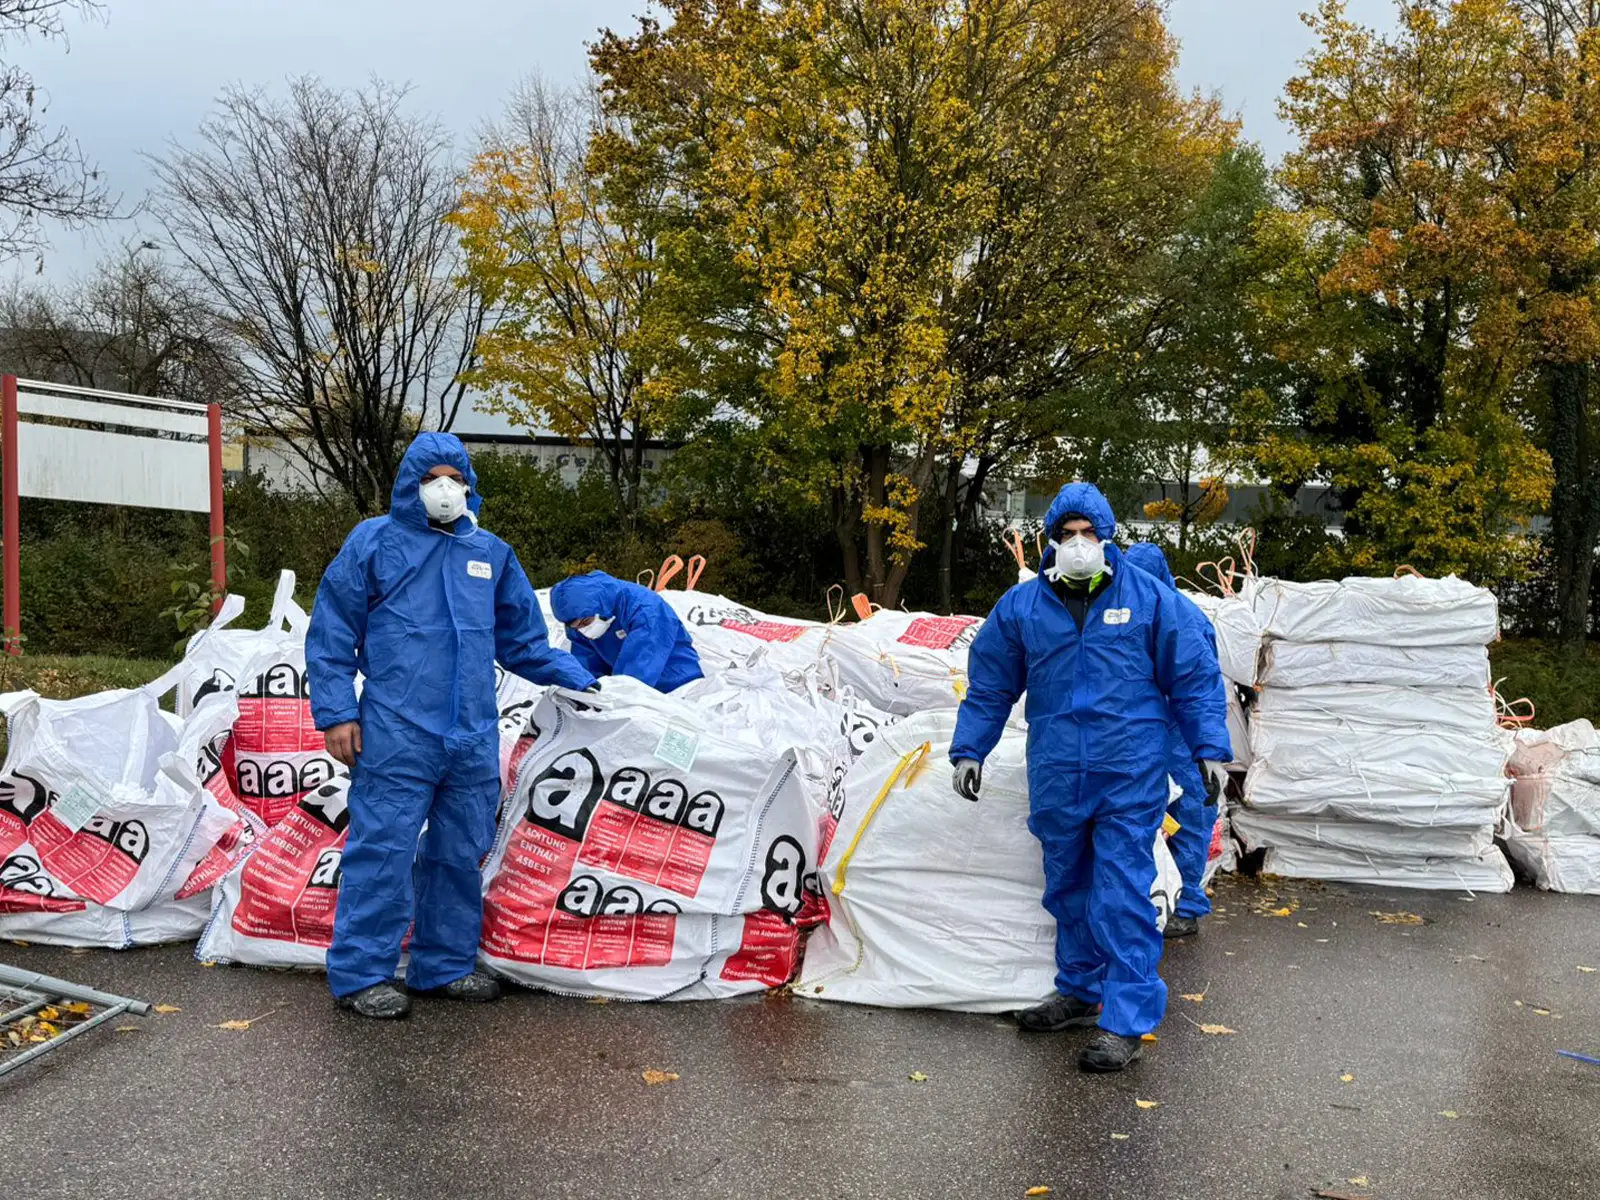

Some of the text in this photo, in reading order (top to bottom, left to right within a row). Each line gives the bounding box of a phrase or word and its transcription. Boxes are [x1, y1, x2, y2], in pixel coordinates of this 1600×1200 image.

[266, 665, 297, 697] a
[238, 760, 260, 796] a
[265, 762, 295, 796] a
[530, 750, 597, 833] a
[608, 767, 722, 834] a a a
[118, 820, 148, 862] a
[287, 811, 323, 837] CHTUNG
[526, 827, 567, 851] ACHTUNG
[310, 850, 339, 886] a
[515, 855, 553, 875] ASBEST
[764, 839, 803, 916] a
[561, 876, 600, 916] a
